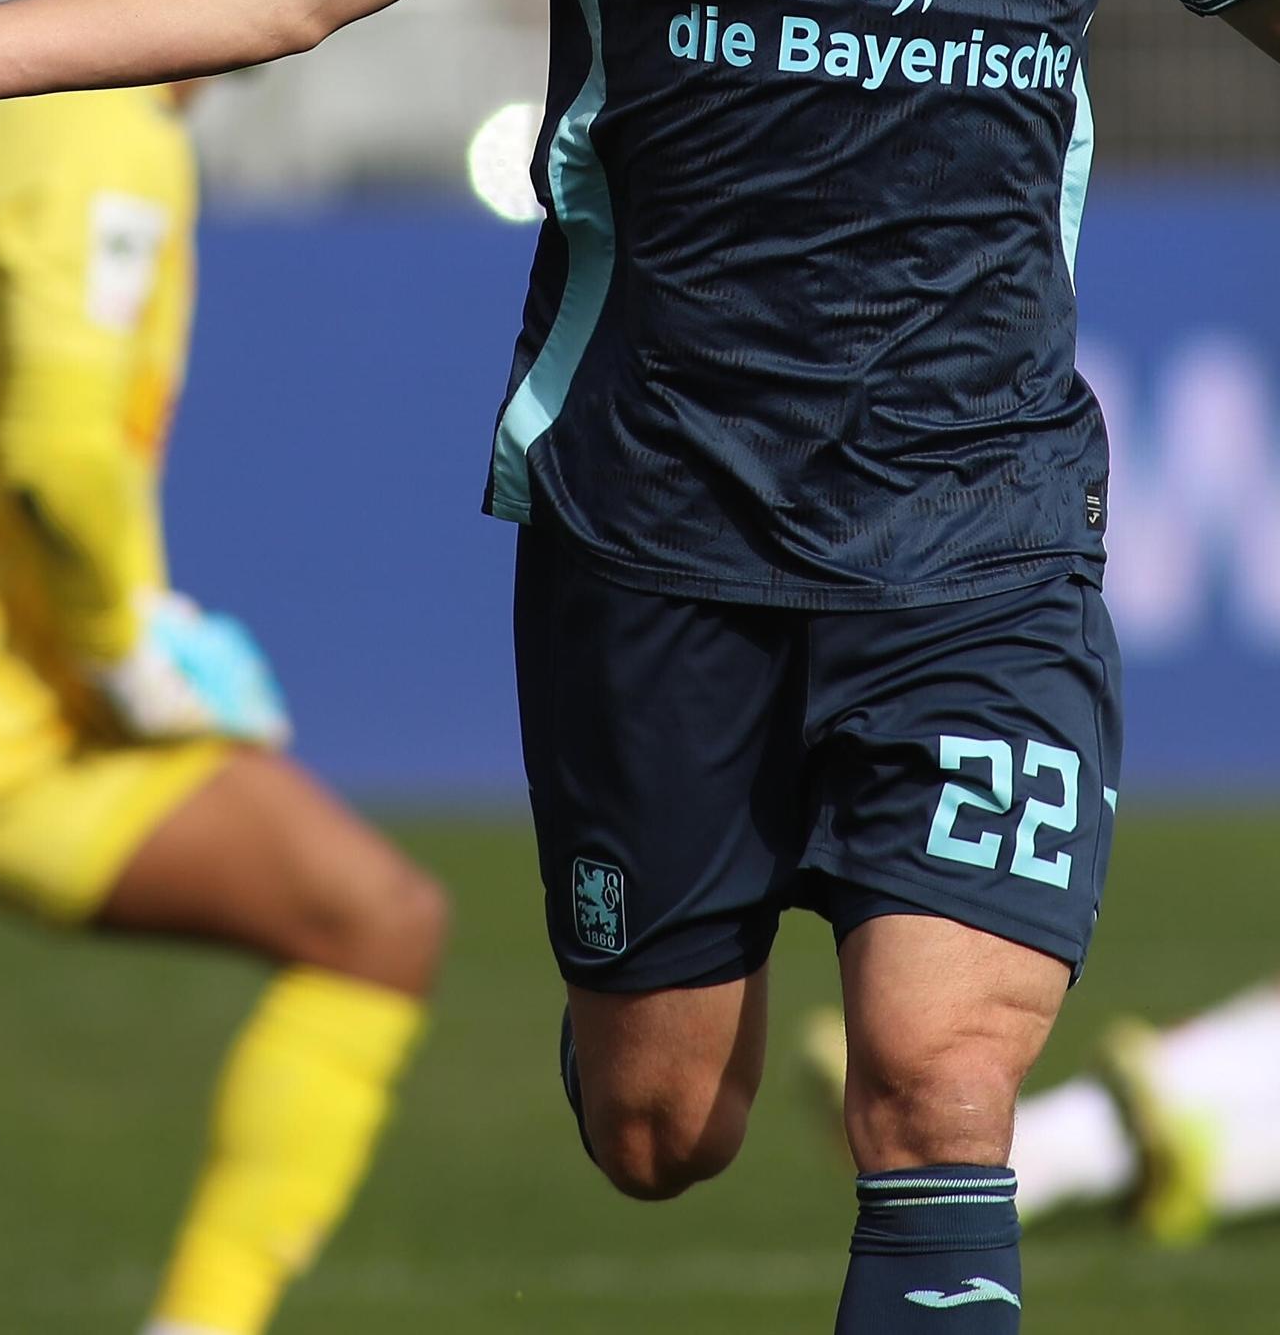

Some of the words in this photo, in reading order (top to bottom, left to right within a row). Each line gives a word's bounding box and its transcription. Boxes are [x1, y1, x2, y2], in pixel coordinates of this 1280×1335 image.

[668, 3, 756, 67] die
[777, 15, 1072, 90] Bayerische
[925, 734, 1083, 890] 22
[585, 929, 616, 949] 1860
